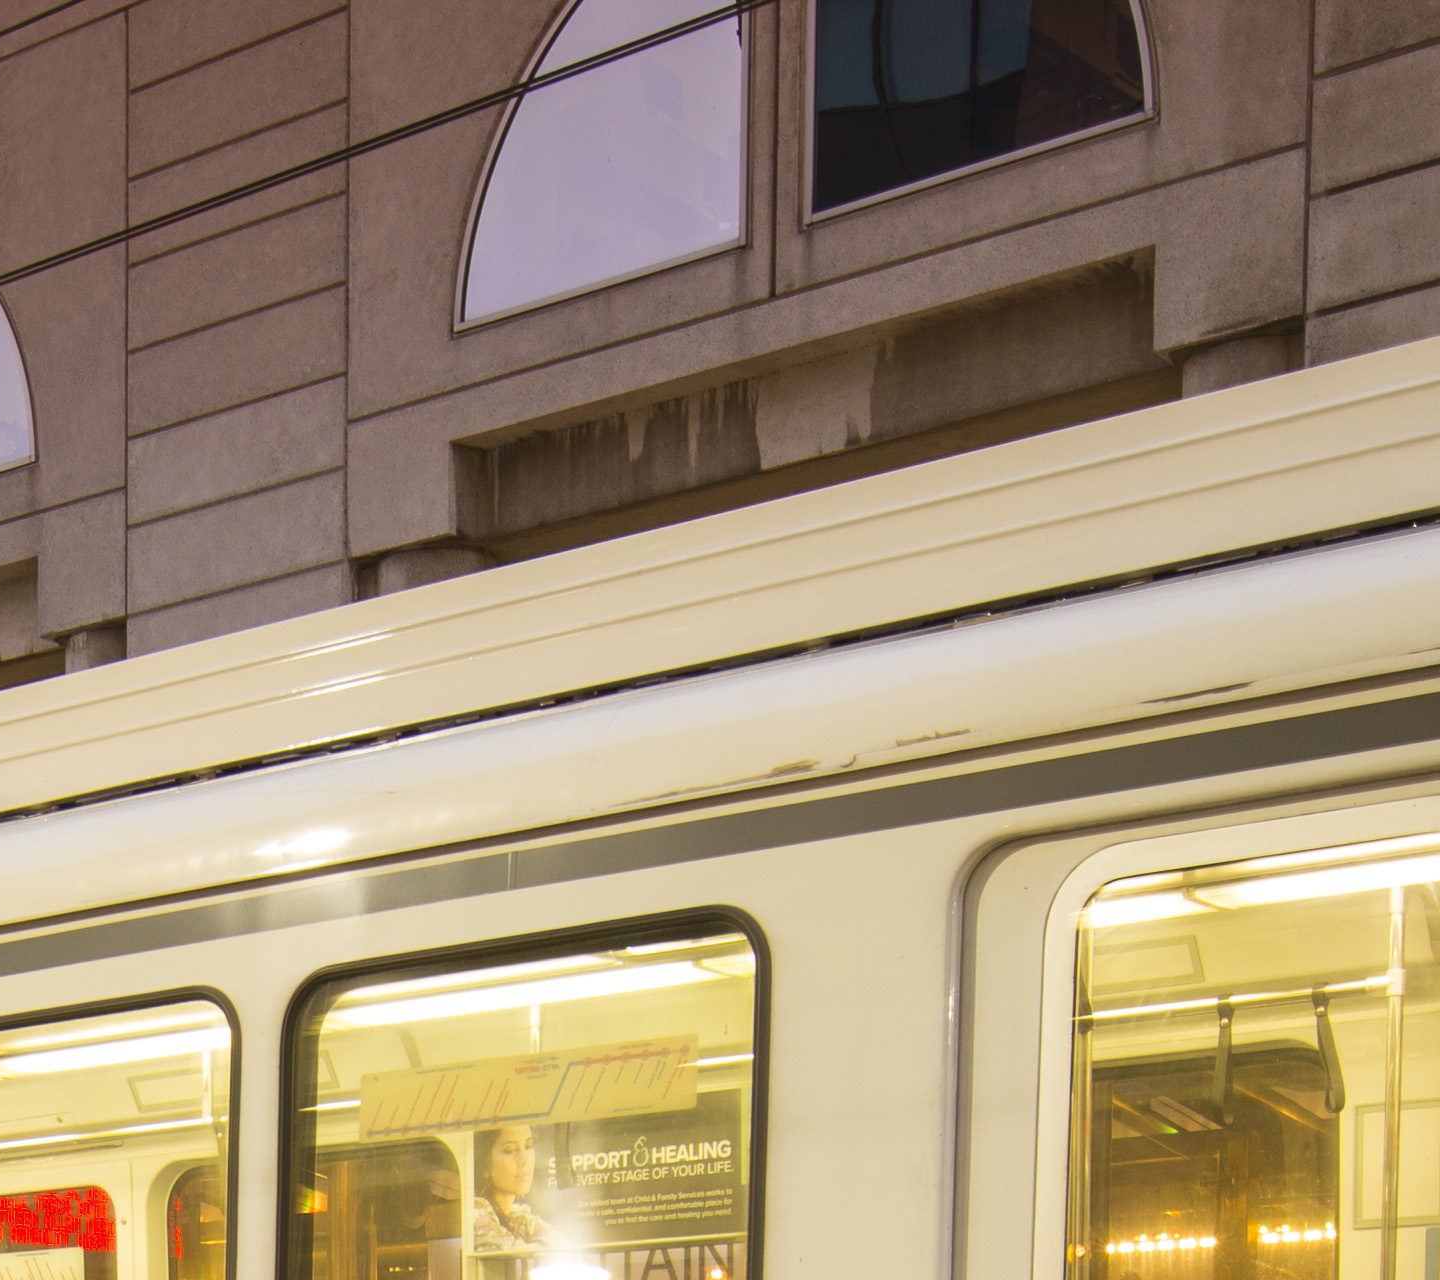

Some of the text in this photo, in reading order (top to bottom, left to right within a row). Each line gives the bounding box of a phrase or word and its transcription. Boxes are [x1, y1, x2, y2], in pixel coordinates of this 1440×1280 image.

[548, 1149, 632, 1175] SPPORT
[652, 1140, 732, 1165] HEALING
[613, 1168, 650, 1184] STAGE
[652, 1167, 669, 1180] OF
[671, 1163, 705, 1178] YOUR
[708, 1160, 735, 1175] LIFE.
[657, 1193, 677, 1203] Family
[678, 1191, 705, 1200] Services
[654, 1203, 666, 1211] and
[668, 1201, 704, 1210] comfortable
[705, 1199, 723, 1209] place
[723, 1198, 733, 1206] for
[625, 1216, 637, 1224] find
[678, 1211, 700, 1220] healing
